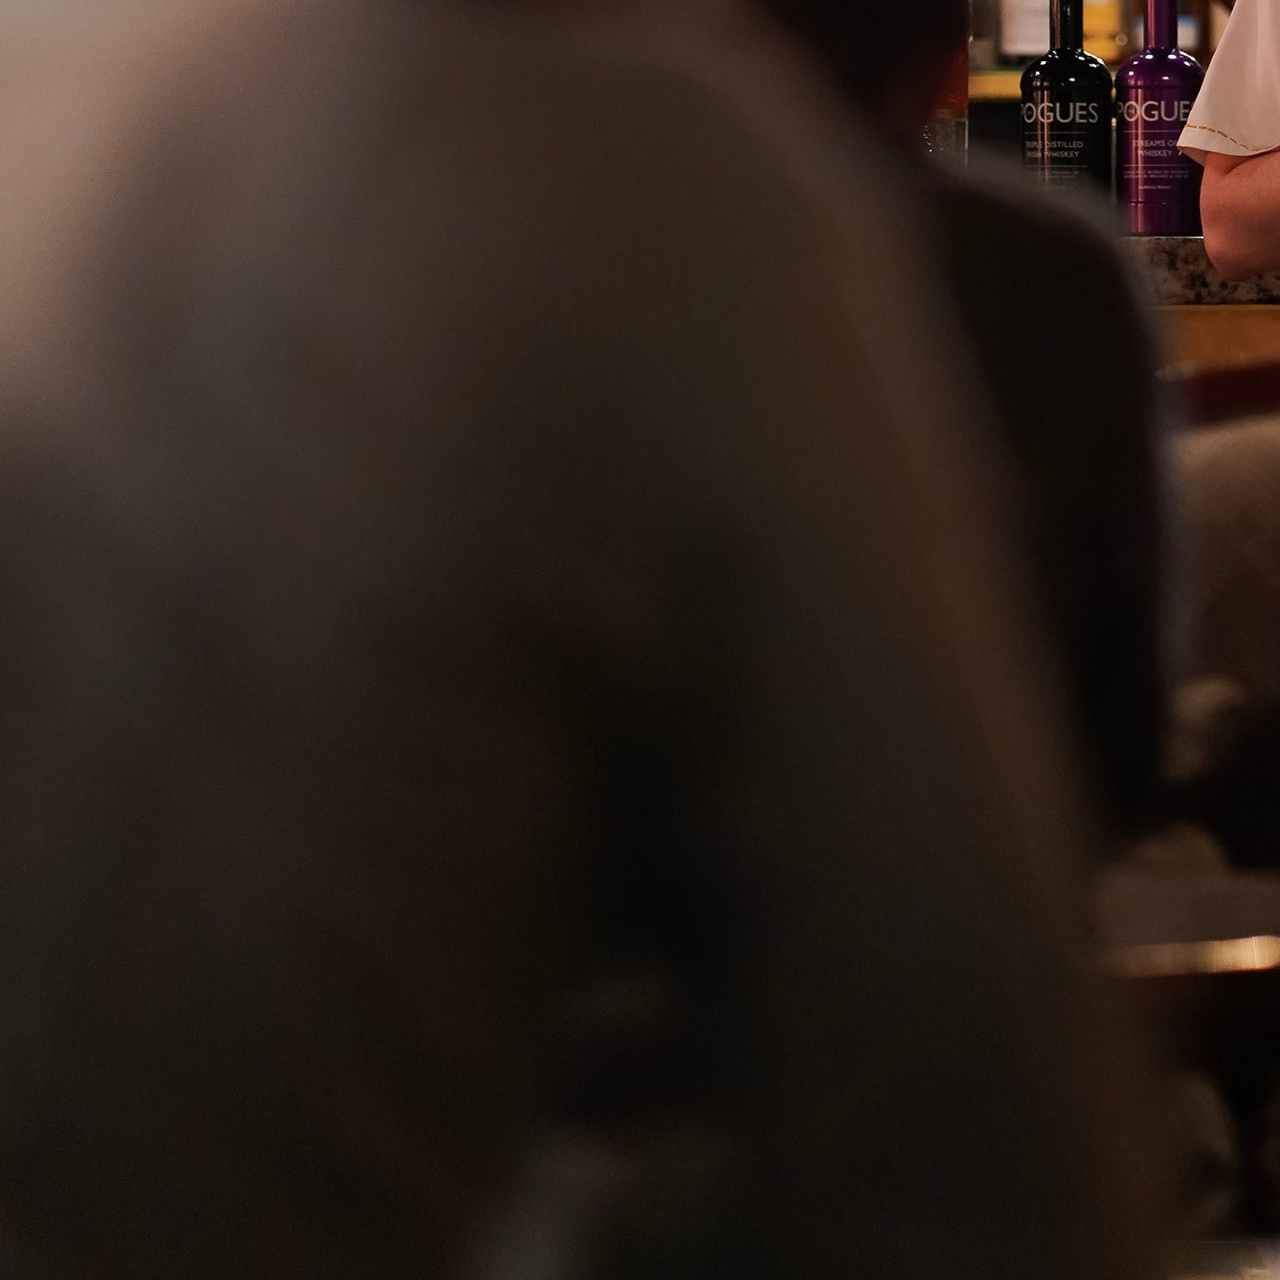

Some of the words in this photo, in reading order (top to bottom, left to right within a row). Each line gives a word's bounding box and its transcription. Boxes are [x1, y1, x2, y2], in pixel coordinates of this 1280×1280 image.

[1117, 100, 1193, 122] POGUE
[1045, 141, 1084, 149] DISTILLED
[1043, 151, 1080, 159] WHISKEY
